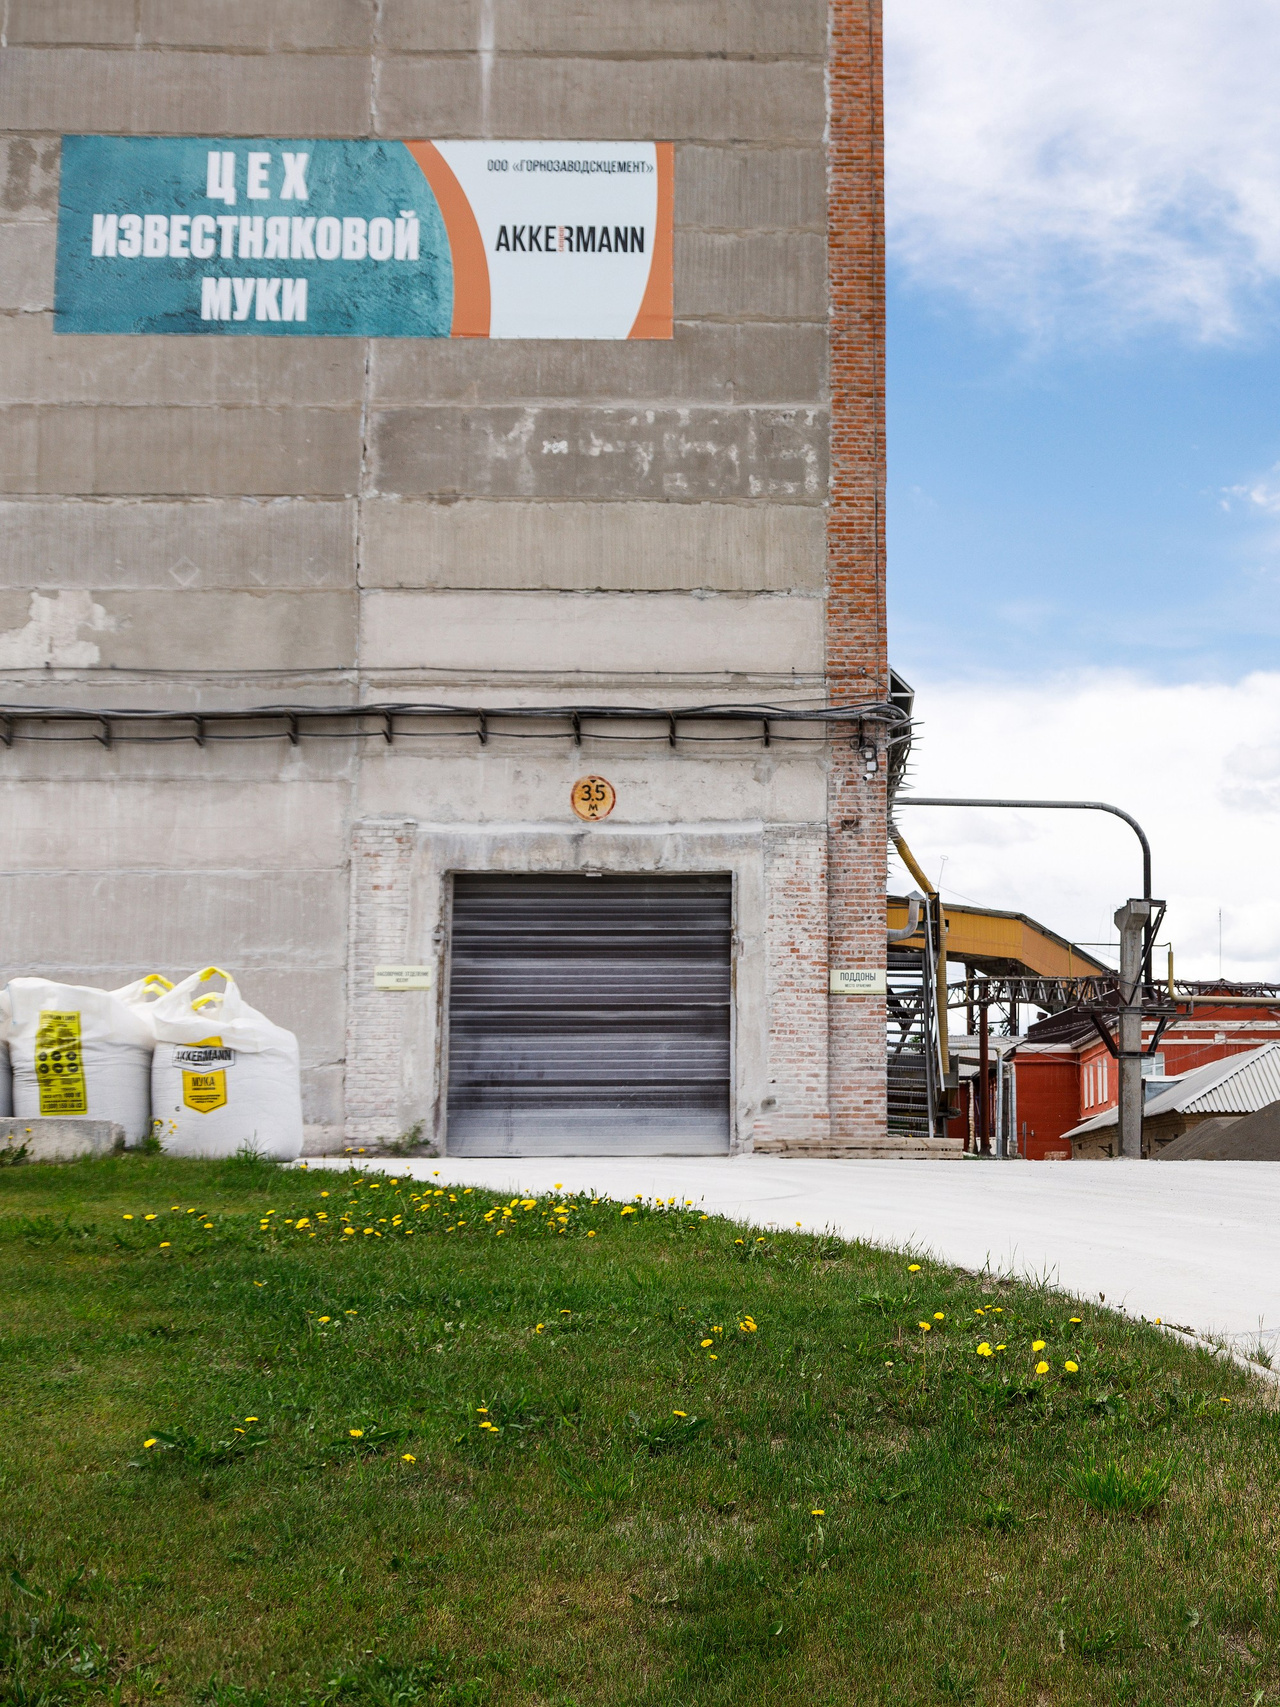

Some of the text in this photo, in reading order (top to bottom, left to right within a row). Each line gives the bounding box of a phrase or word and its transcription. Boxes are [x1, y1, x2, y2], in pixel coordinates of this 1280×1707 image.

[206, 151, 310, 204] ЦЕХ
[487, 159, 654, 174] ООО «ГОРНОЗАВОДСКЦЕМЕНТ»
[91, 210, 420, 261] ИЗВЕСТНЯКОВОЙ
[495, 224, 645, 253] AKKERMANN
[200, 277, 308, 322] МУКИ
[840, 972, 876, 982] ПОДДОНЫ
